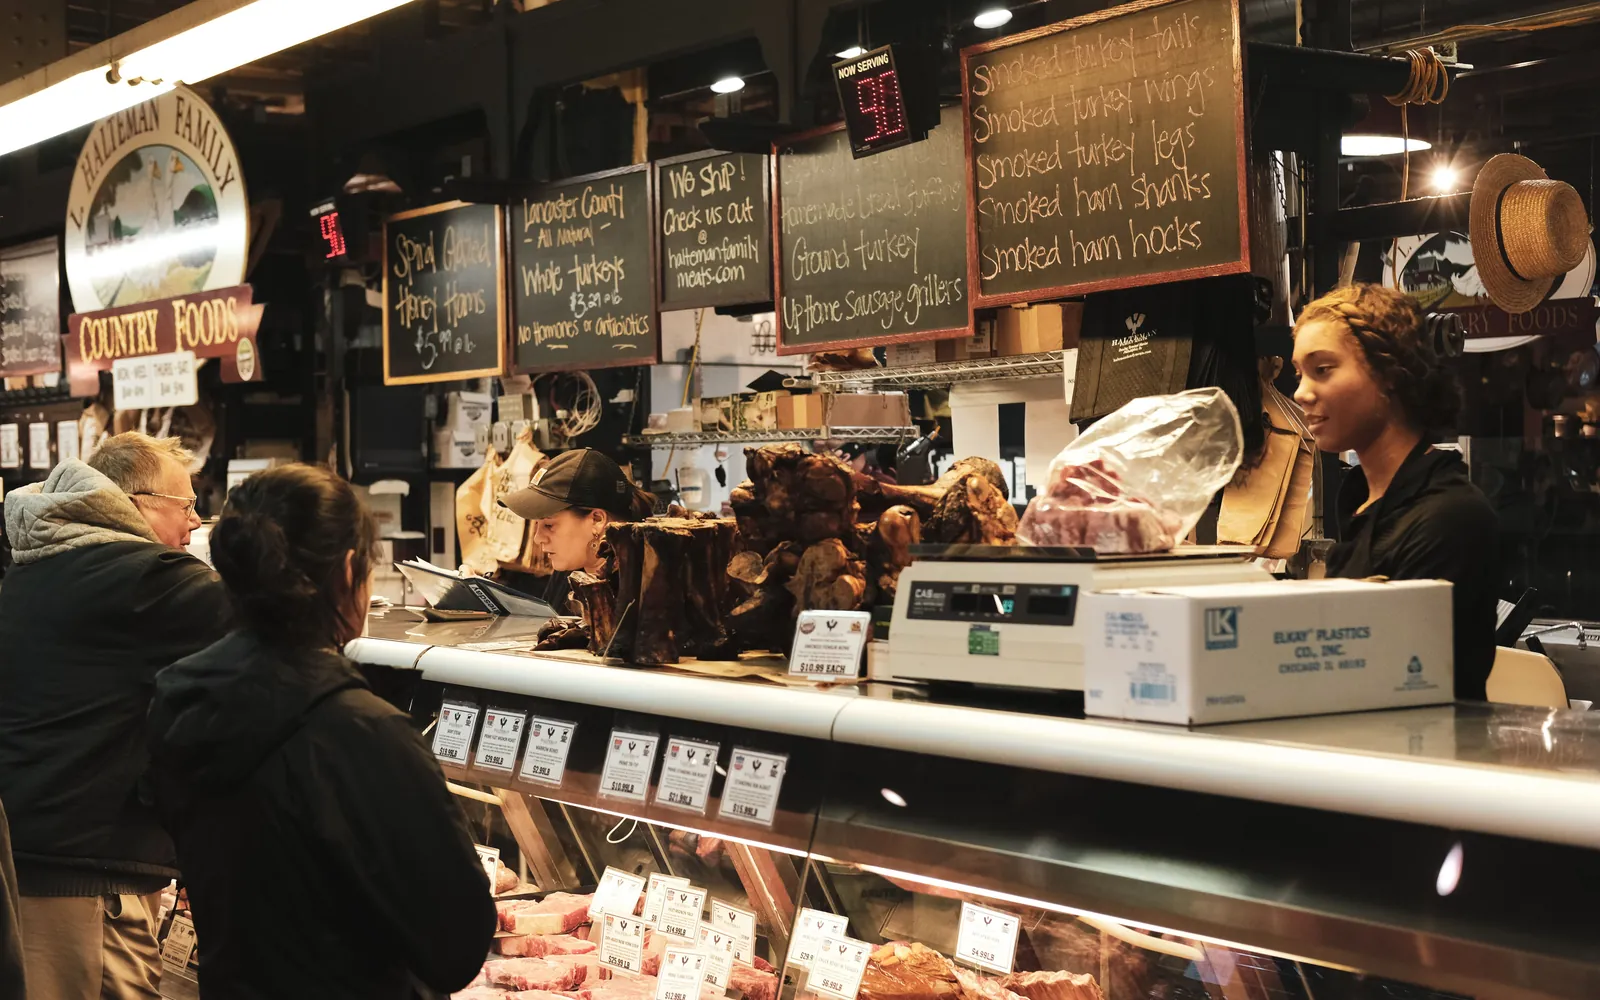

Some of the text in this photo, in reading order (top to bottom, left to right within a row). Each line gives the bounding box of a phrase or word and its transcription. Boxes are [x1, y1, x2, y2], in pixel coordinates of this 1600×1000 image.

[1066, 28, 1138, 77] turkey
[1146, 12, 1200, 58] tails
[838, 53, 889, 79] NOW SERVING
[858, 70, 904, 141] 90
[1065, 82, 1134, 124] turkey
[1144, 66, 1215, 117] wings
[81, 98, 160, 192] HALTEMAN
[175, 96, 236, 198] FAMILY
[1067, 131, 1136, 176] turkey
[1152, 120, 1196, 170] legs
[523, 194, 580, 232] Lancaster
[704, 204, 723, 226] us
[727, 196, 754, 224] out
[1074, 177, 1122, 217] ham
[698, 229, 708, 246] @
[792, 227, 920, 281] Ground turkey
[1070, 230, 1122, 266] ham
[1129, 216, 1202, 258] hocks
[522, 254, 626, 296] Whole turkeys
[676, 262, 745, 288] meats.com
[395, 280, 486, 334] Honey Hams
[906, 274, 962, 325] grillers
[1508, 306, 1579, 333] FOODS
[79, 308, 160, 364] COUNTRY
[172, 296, 240, 352] FOODS
[583, 318, 592, 334] or
[914, 588, 934, 598] CAS
[1316, 626, 1371, 641] PLASTICS
[800, 662, 846, 674] $10.99 EACH
[666, 924, 687, 936] $14.99LB
